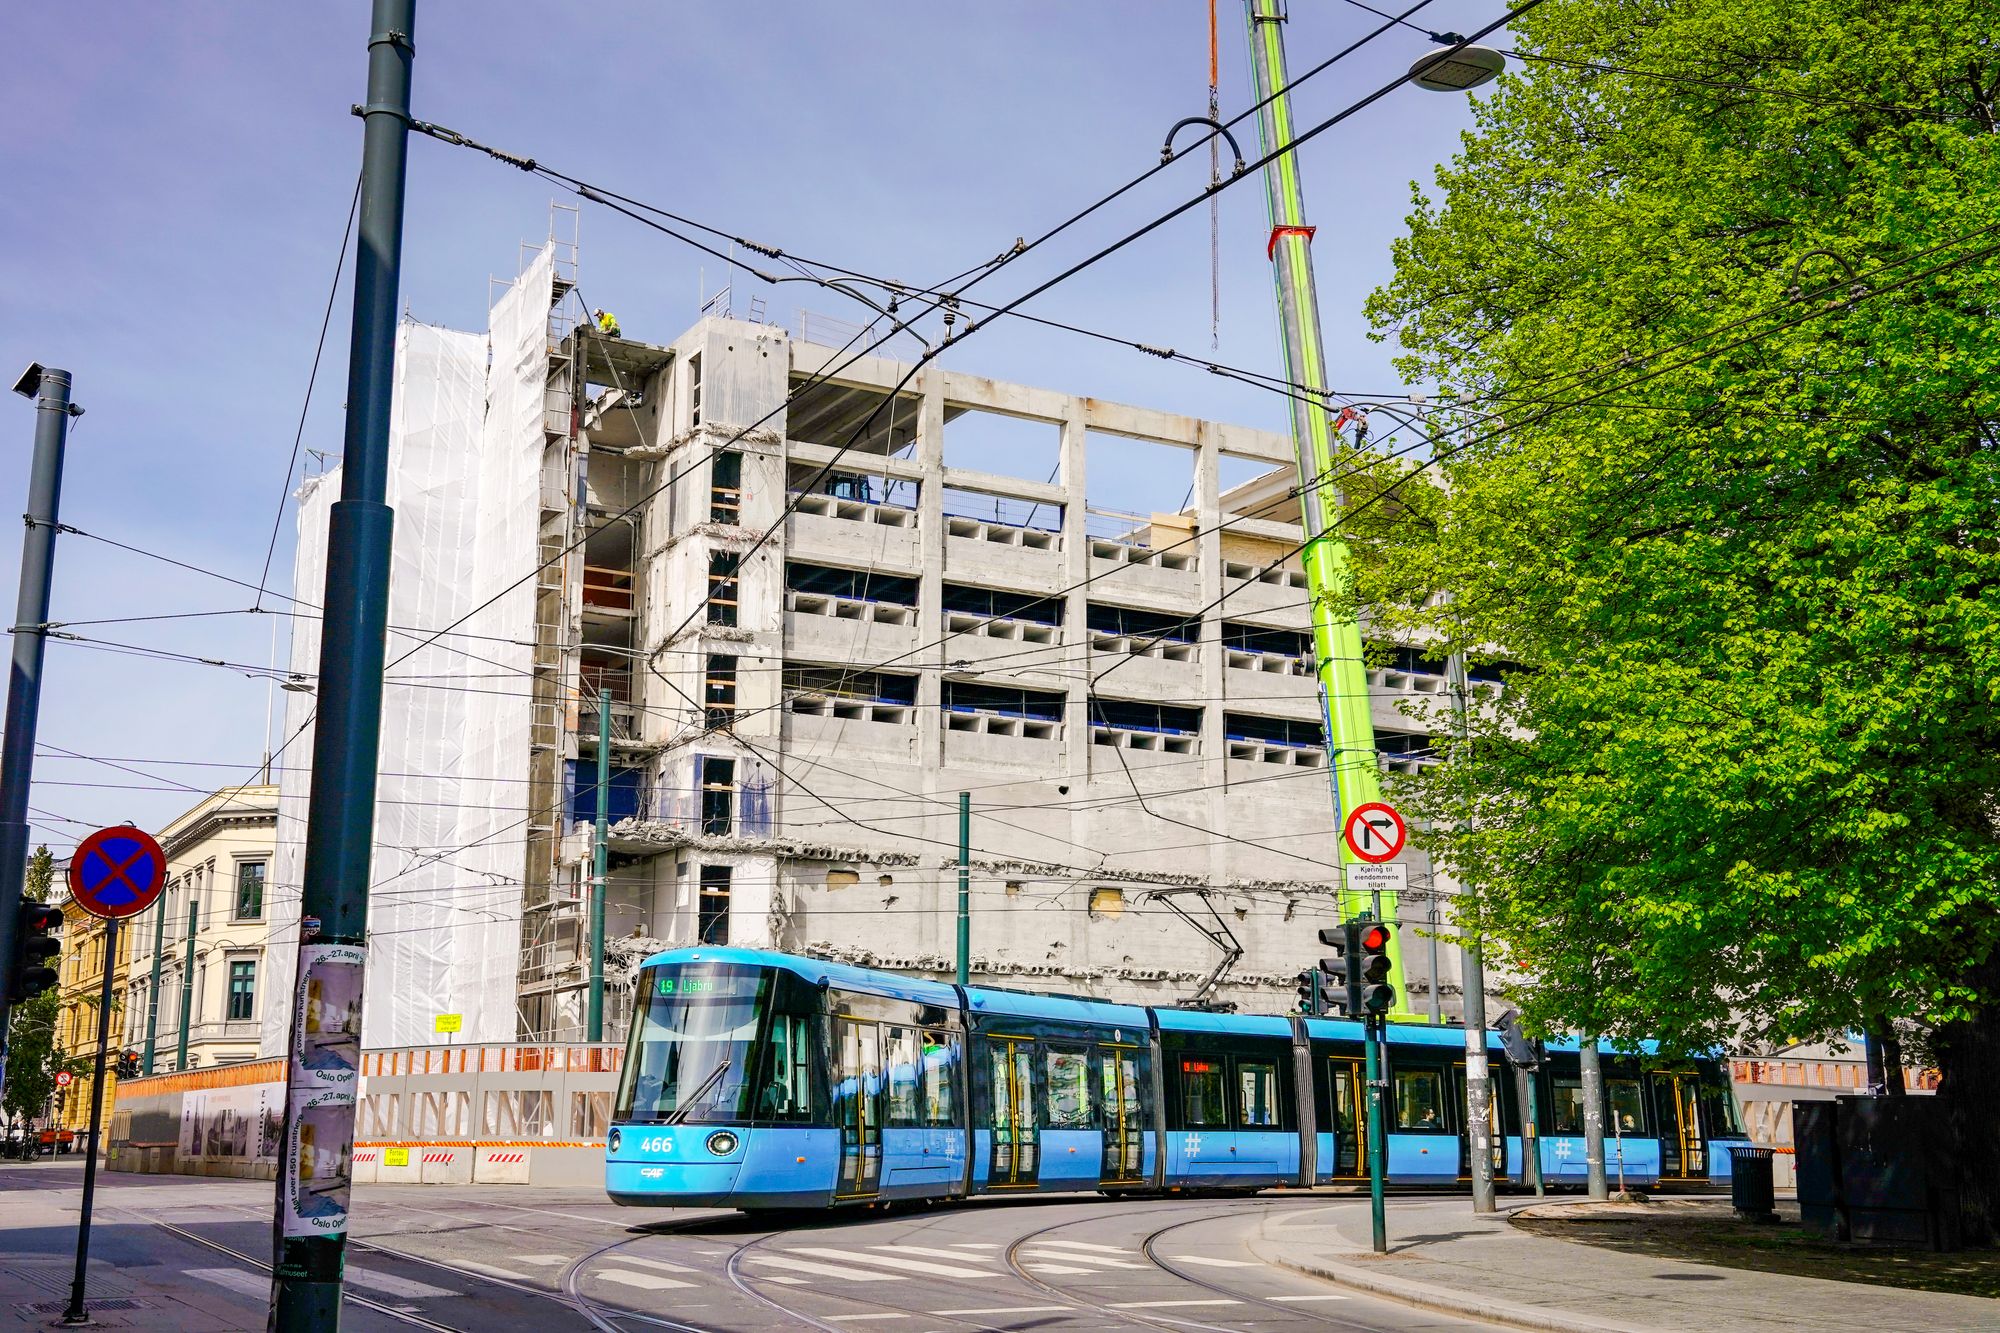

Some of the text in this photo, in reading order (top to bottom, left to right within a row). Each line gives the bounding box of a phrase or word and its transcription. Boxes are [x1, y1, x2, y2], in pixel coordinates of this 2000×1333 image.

[344, 951, 359, 960] april
[299, 970, 312, 1010] kunstnere
[661, 980, 713, 993] 19 Ljabru
[316, 1070, 354, 1083] Oslo Open
[291, 1114, 304, 1156] kunstnere
[641, 1137, 672, 1152] 466
[641, 1168, 664, 1178] CAF
[312, 1217, 330, 1228] Oslo
